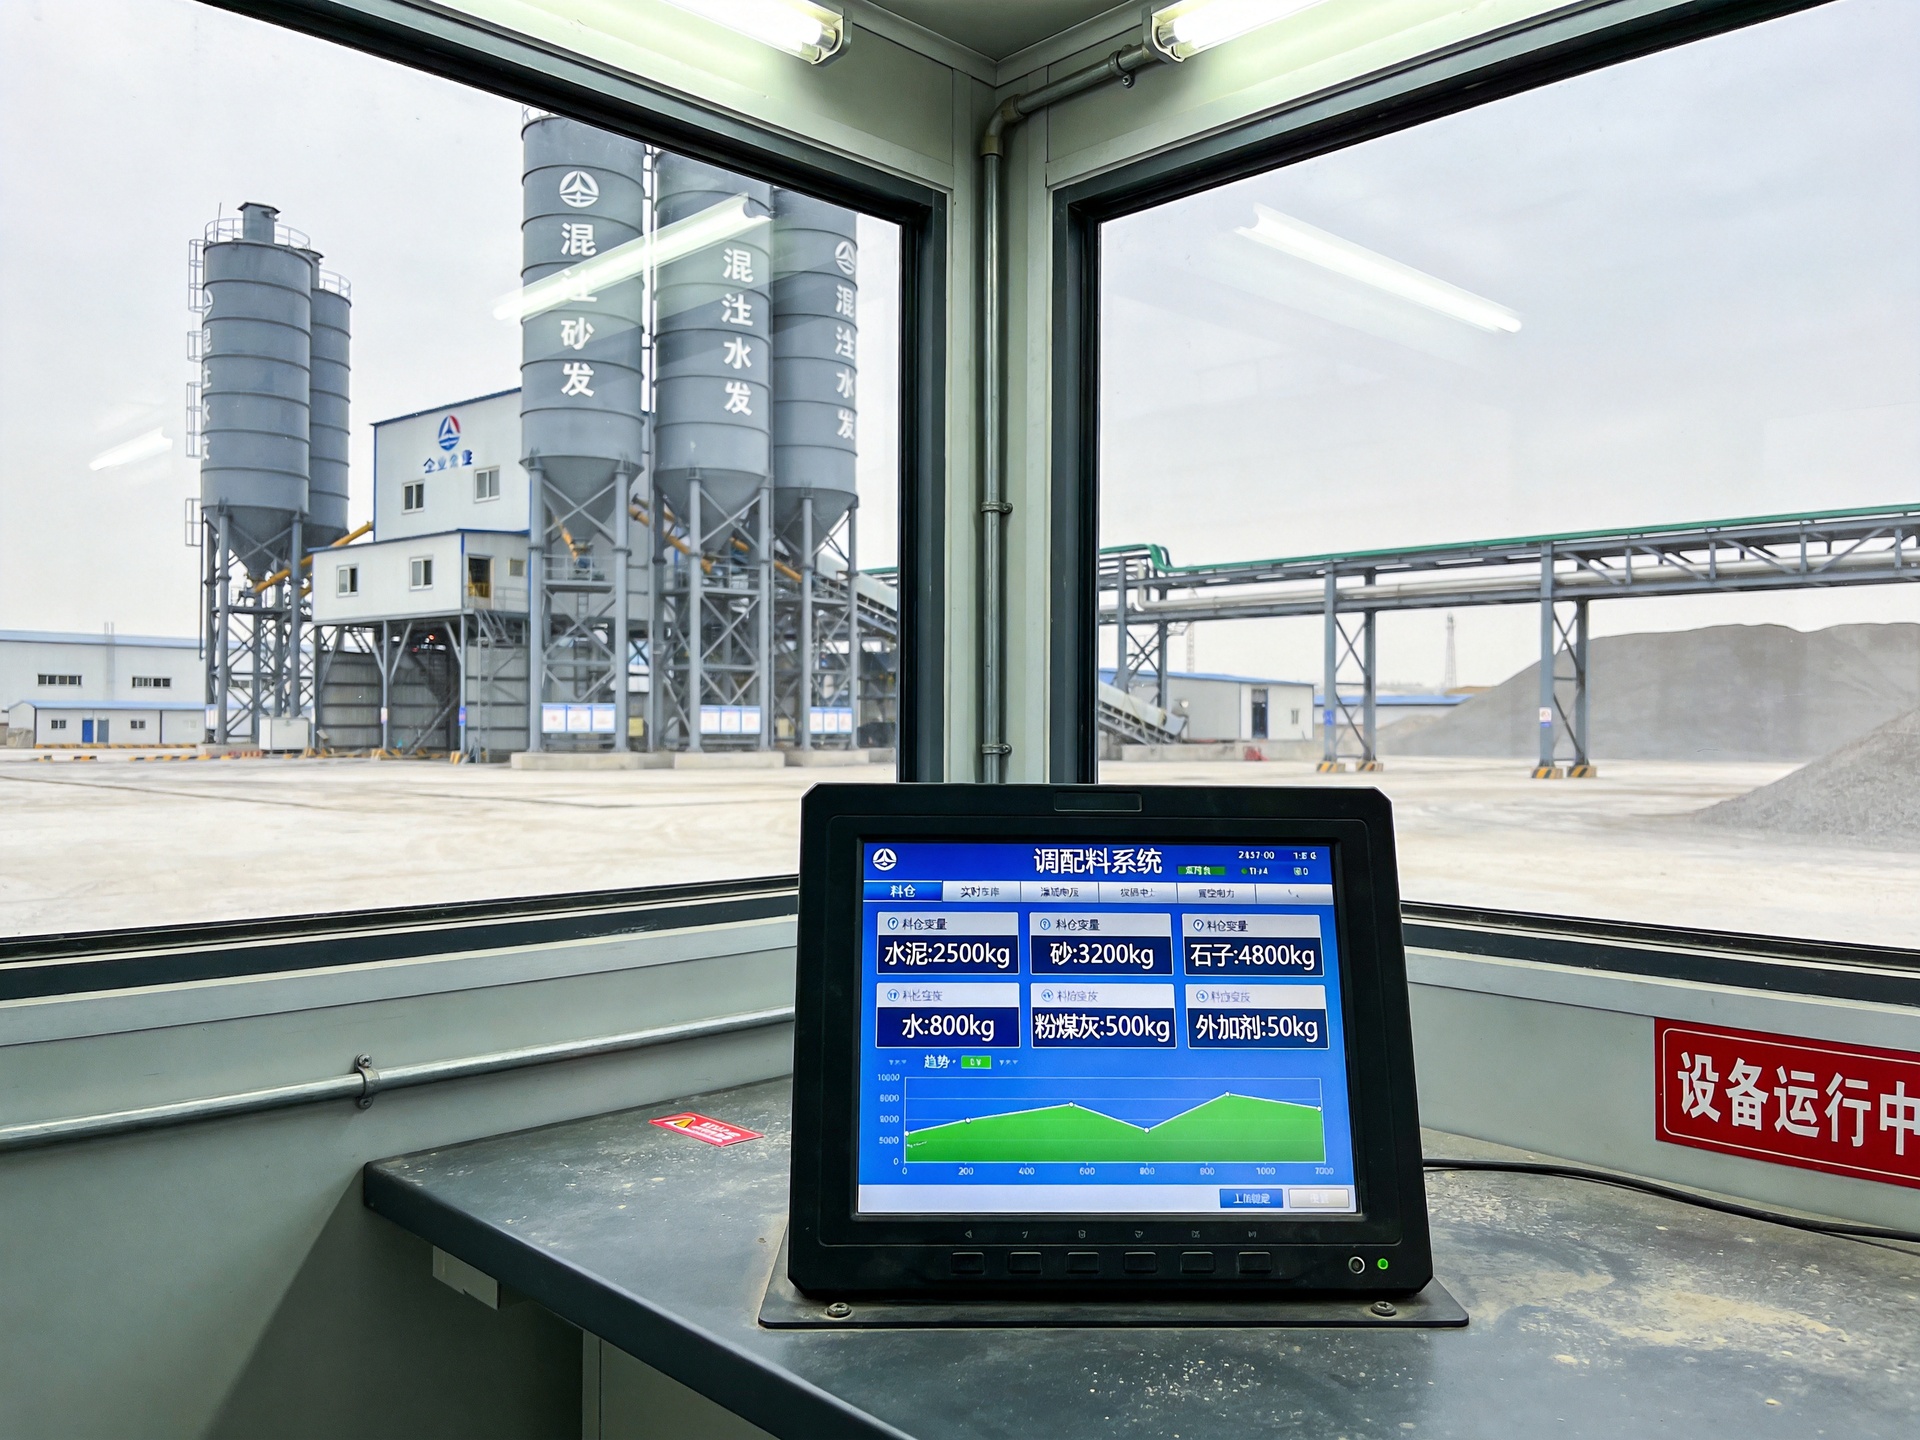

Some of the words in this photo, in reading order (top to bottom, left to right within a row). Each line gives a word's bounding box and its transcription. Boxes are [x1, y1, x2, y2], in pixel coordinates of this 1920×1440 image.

[1034, 848, 1163, 875] 调配料系统
[890, 884, 916, 898] 料仓
[884, 941, 1010, 968] 水泥:2500kg
[1050, 942, 1154, 969] 砂:3200kg
[1190, 944, 1315, 971] 石子:4800kg
[902, 1014, 995, 1041] 水:800kg
[1035, 1014, 1170, 1042] 粉煤灰:500kg
[1196, 1014, 1319, 1042] 外加剂:50kg
[924, 1054, 950, 1069] 趋势
[1677, 1051, 1920, 1156] 设备运行中
[893, 1157, 899, 1165] 0
[902, 1167, 908, 1176] 0
[958, 1167, 974, 1176] 200
[1018, 1167, 1035, 1176] 400
[1079, 1167, 1096, 1176] 600
